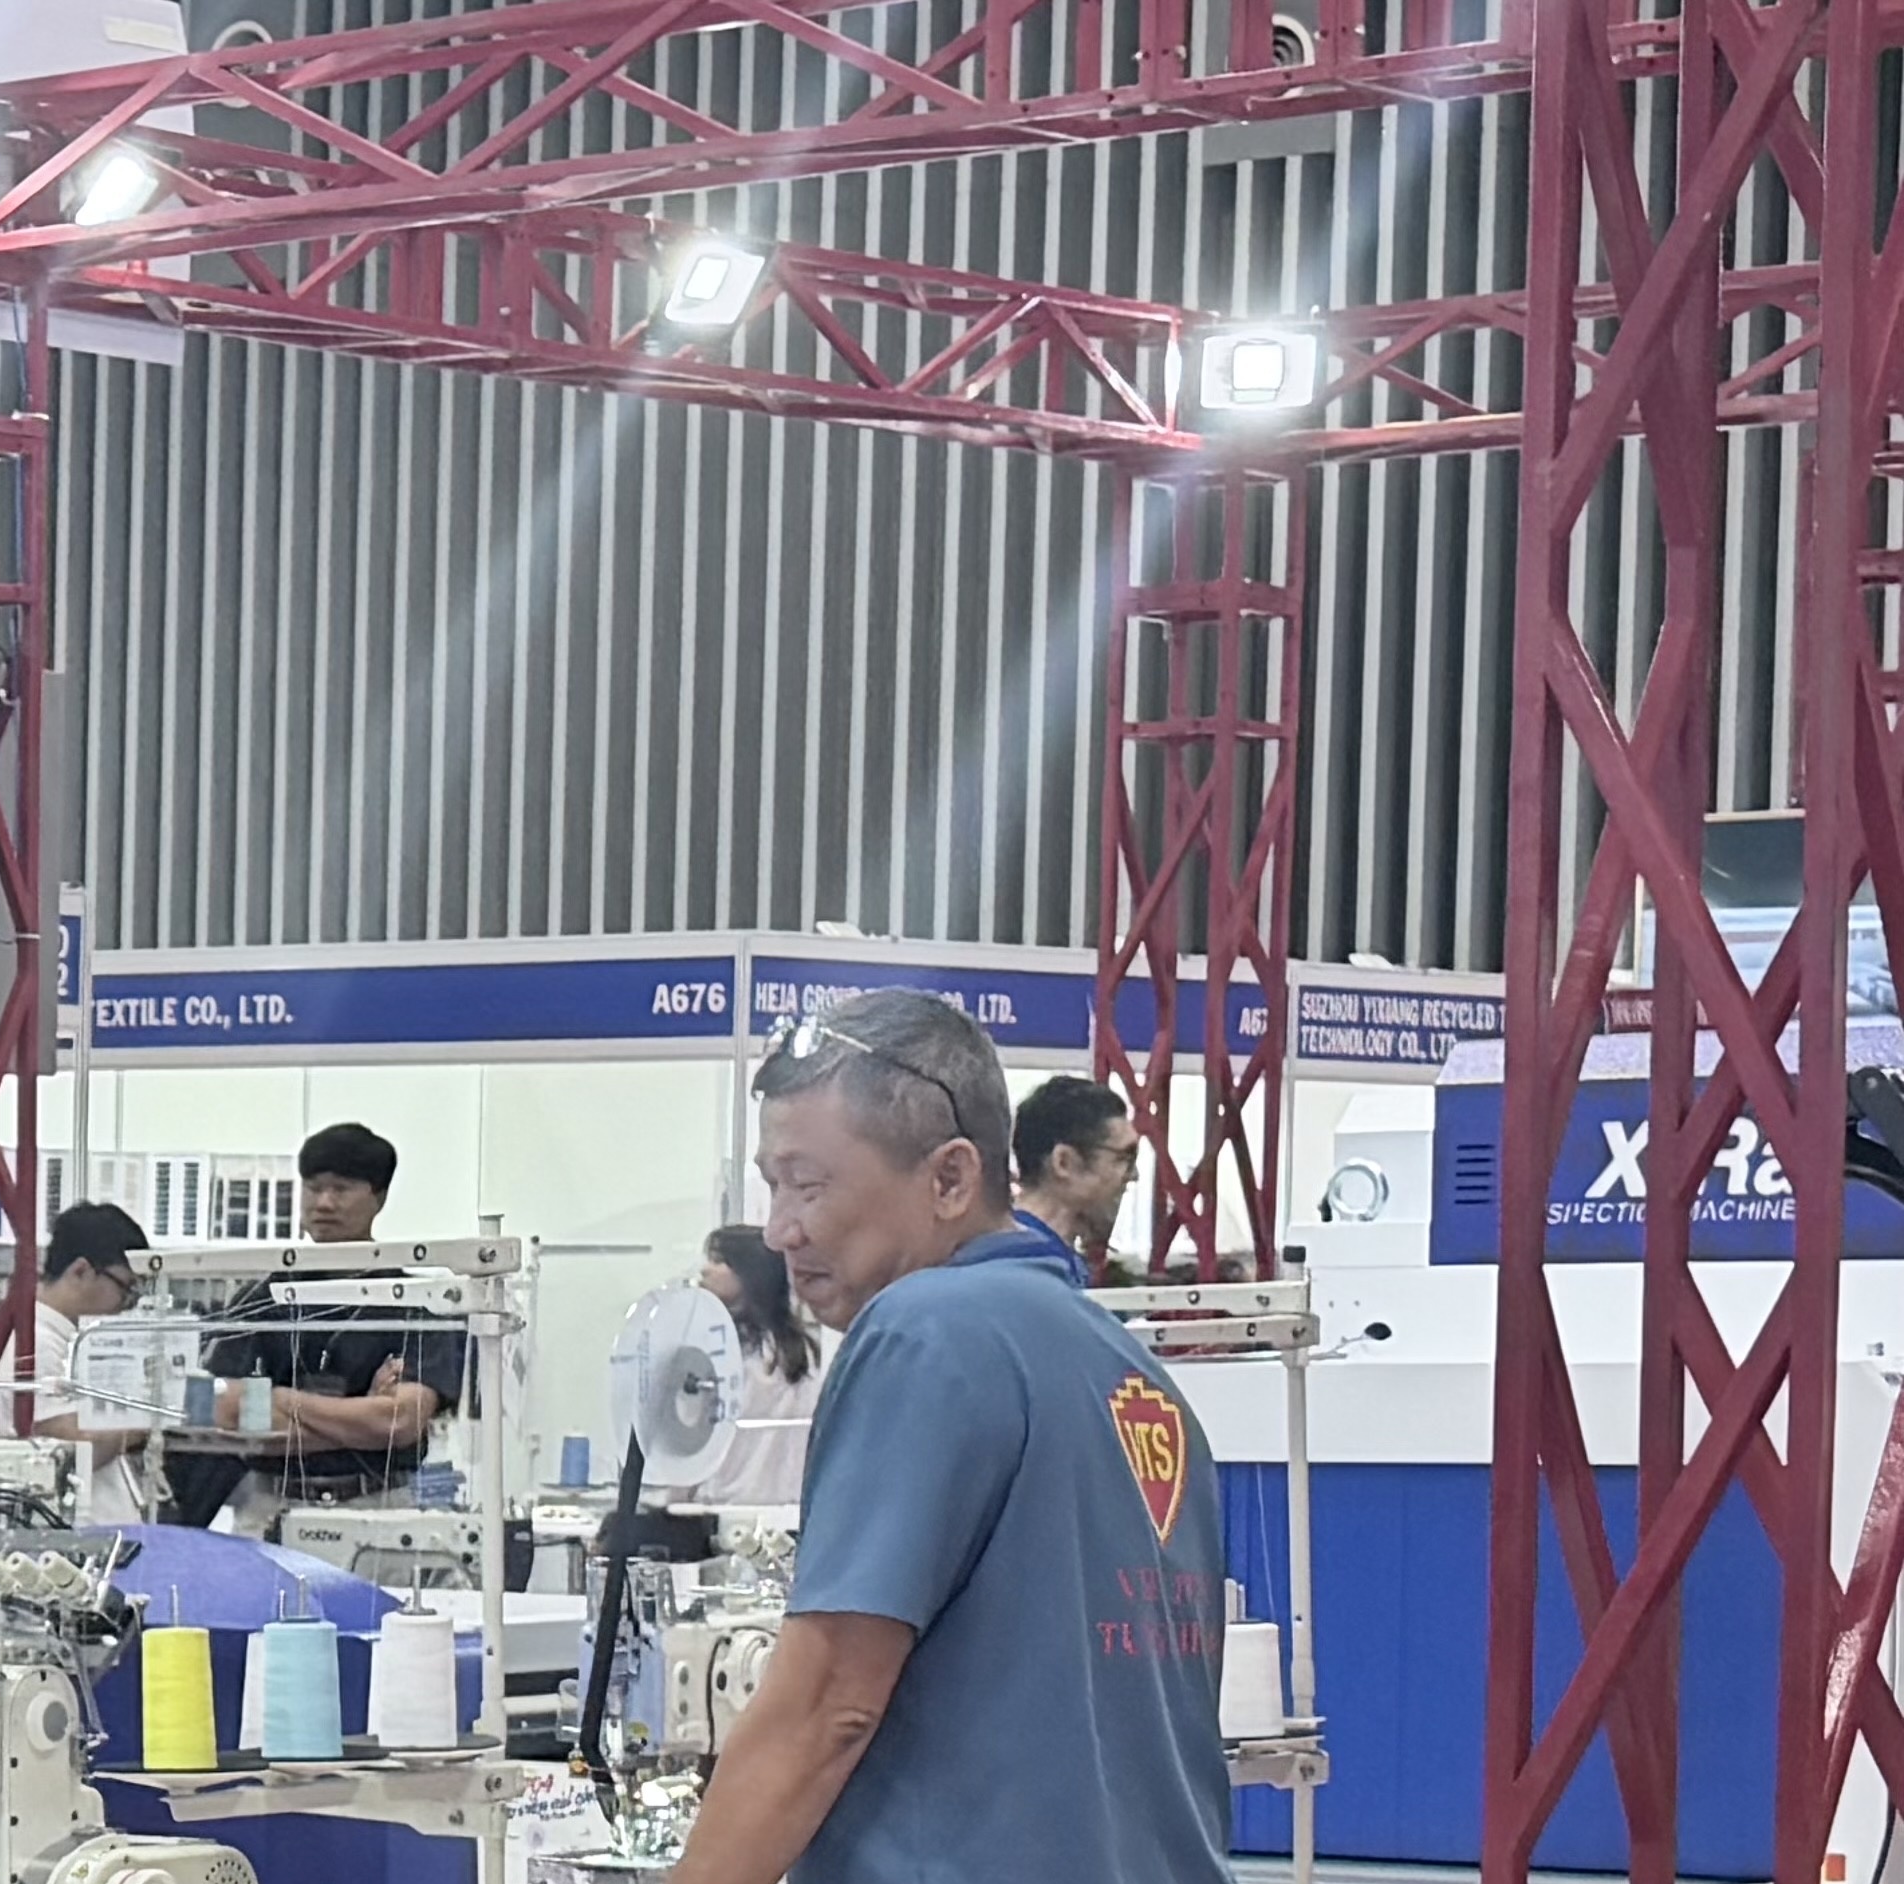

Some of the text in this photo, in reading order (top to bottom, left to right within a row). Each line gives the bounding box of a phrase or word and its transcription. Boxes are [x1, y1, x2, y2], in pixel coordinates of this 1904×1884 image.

[93, 994, 295, 1034] EXTILE CO., LTD.
[652, 983, 727, 1014] A676
[1239, 1006, 1270, 1034] A67
